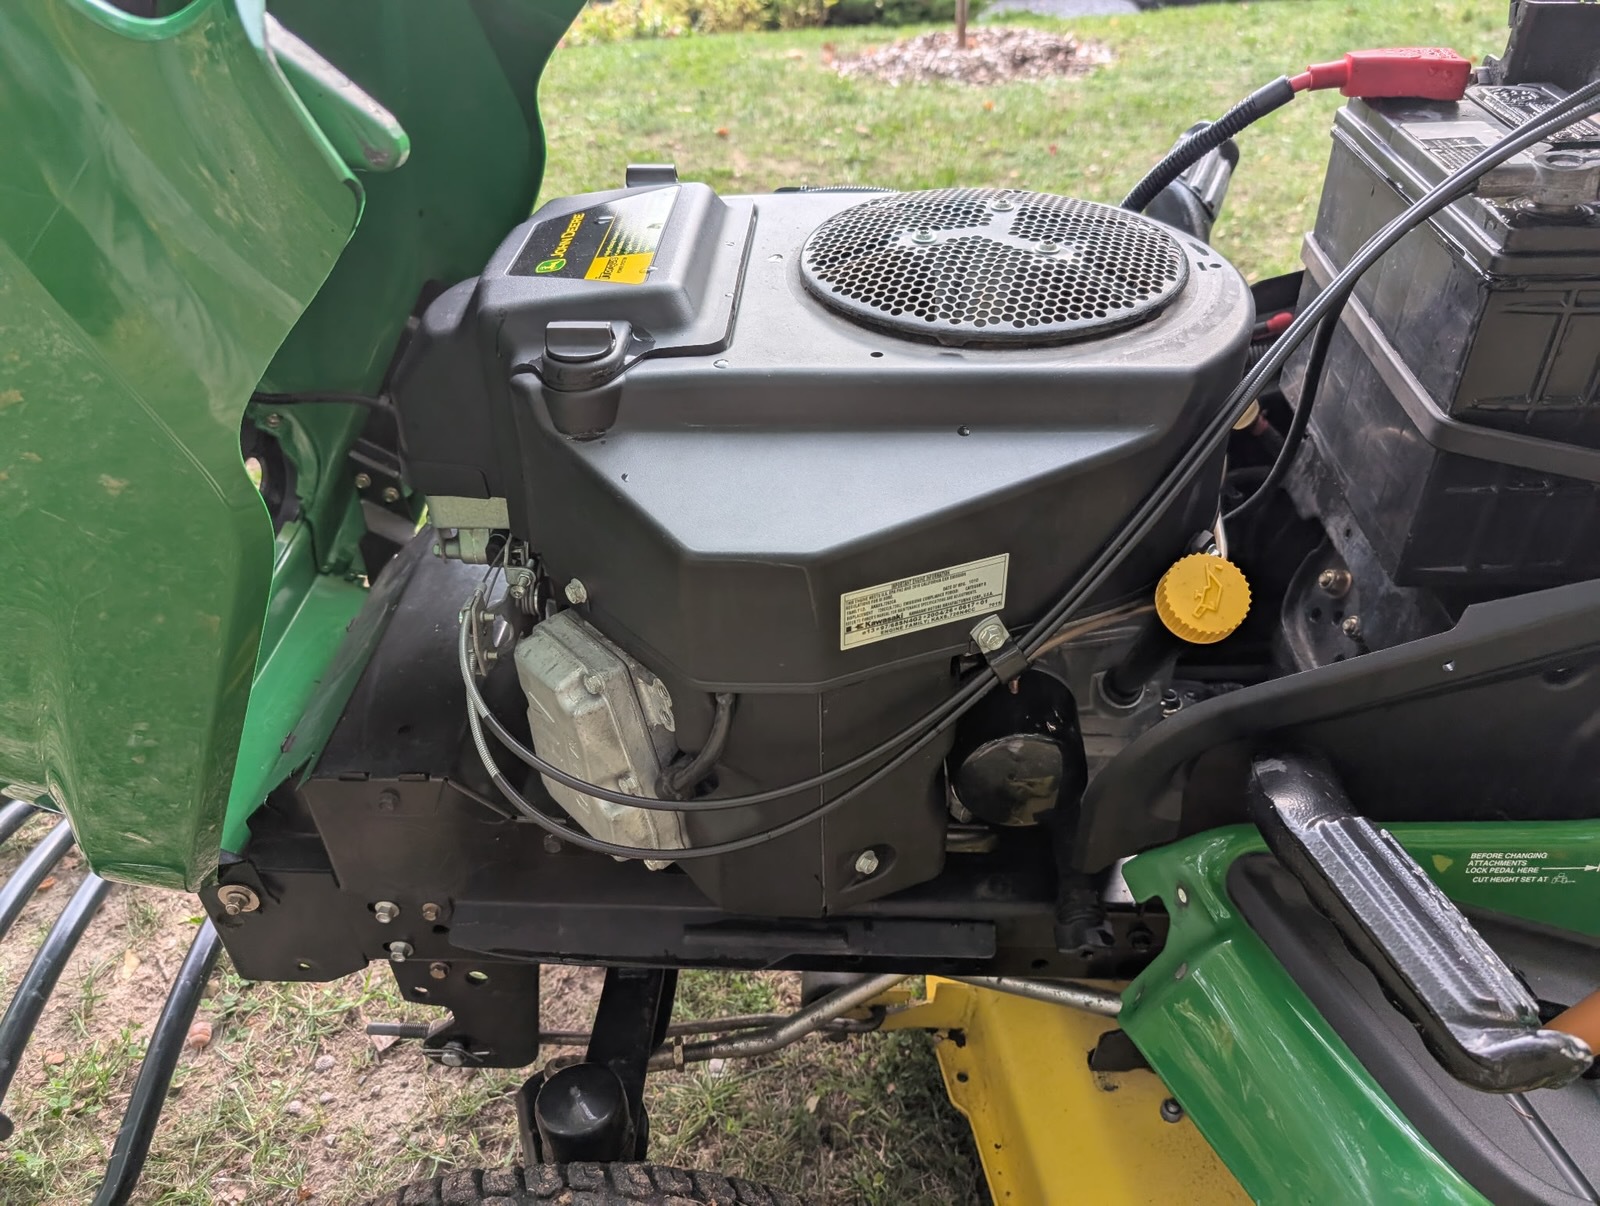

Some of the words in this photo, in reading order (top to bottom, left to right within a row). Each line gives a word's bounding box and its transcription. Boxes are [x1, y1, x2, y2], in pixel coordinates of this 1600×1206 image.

[561, 212, 585, 238] DEERE
[551, 238, 573, 258] JOHN
[865, 612, 903, 627] Kawasaki
[880, 625, 903, 634] ENGINE
